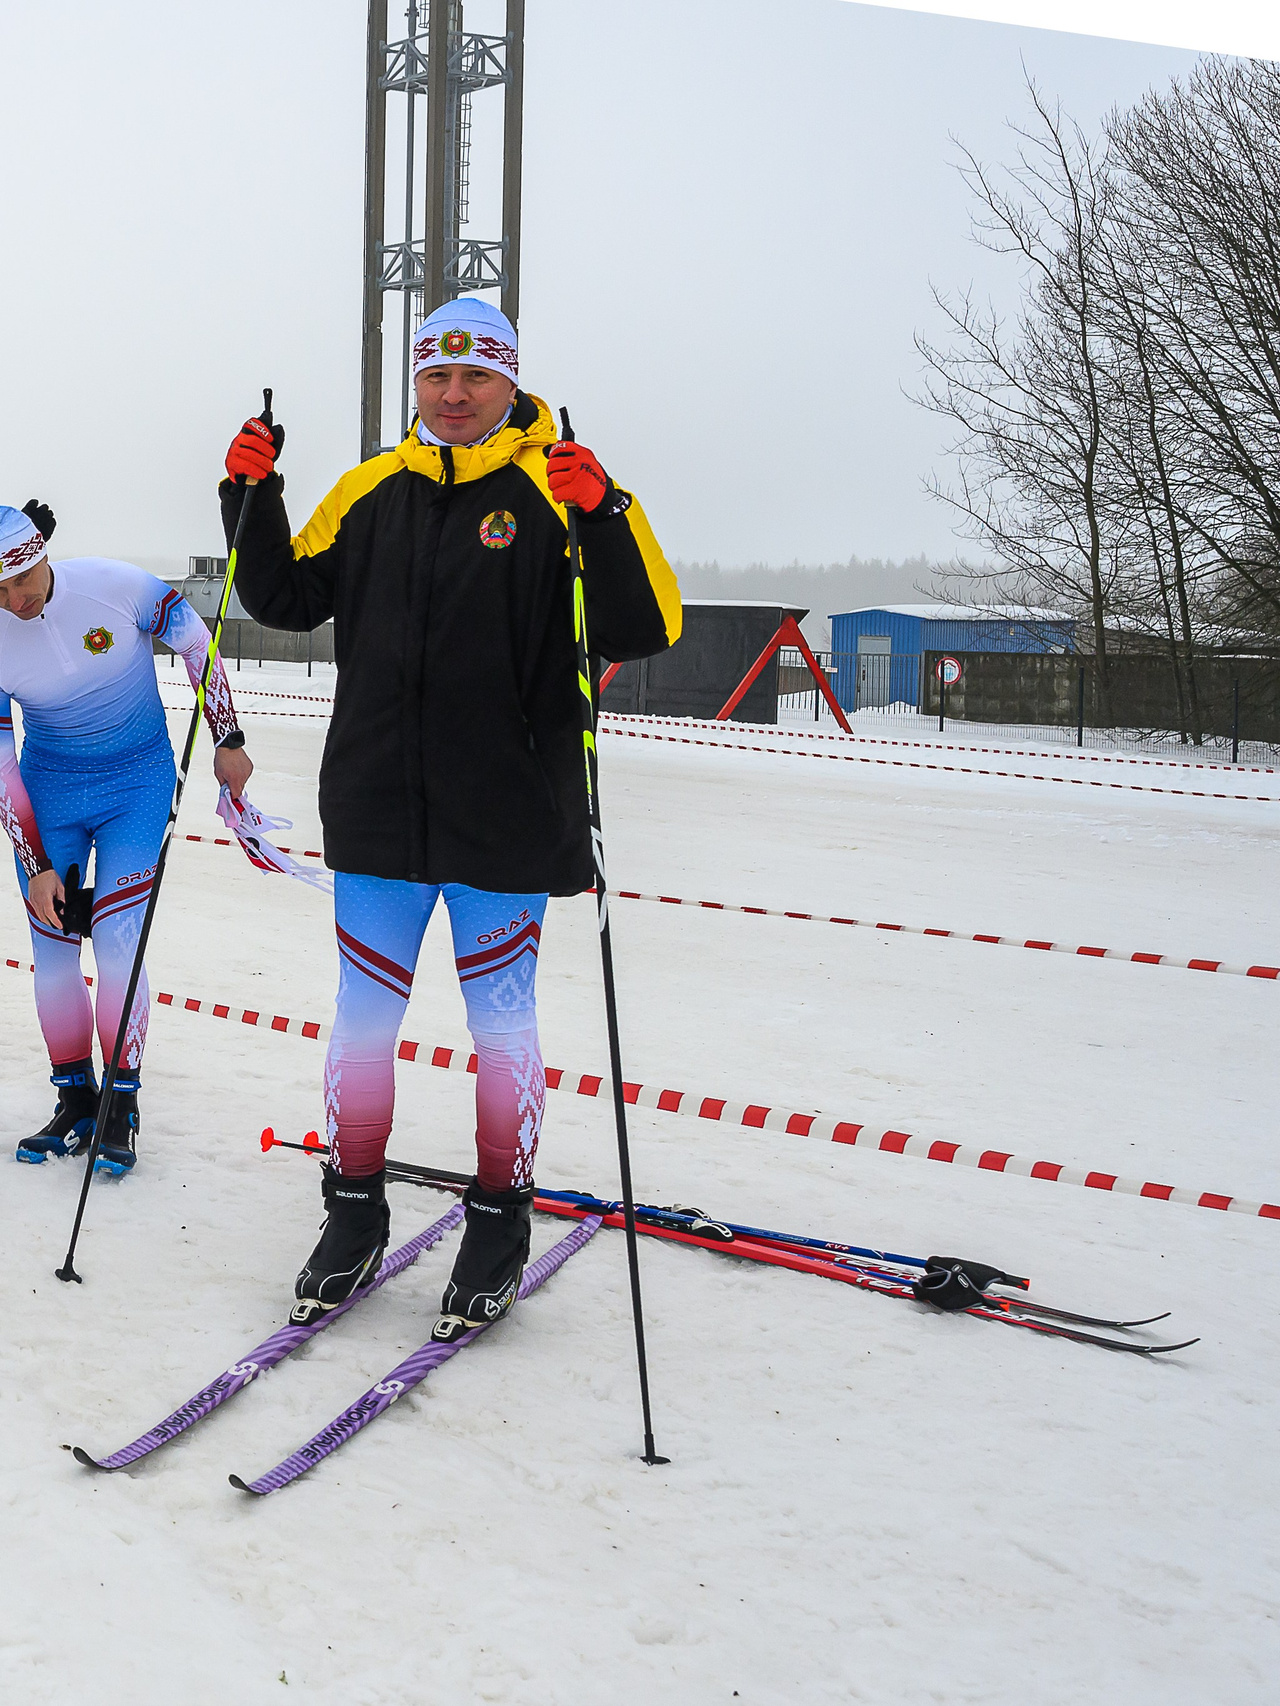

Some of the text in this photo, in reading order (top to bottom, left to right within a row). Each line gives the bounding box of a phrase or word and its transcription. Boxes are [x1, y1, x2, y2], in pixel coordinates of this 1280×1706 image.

[476, 908, 531, 945] ORAZ
[151, 1379, 232, 1439] SNOWWAVE
[301, 1398, 379, 1459] SNOWWAVE
